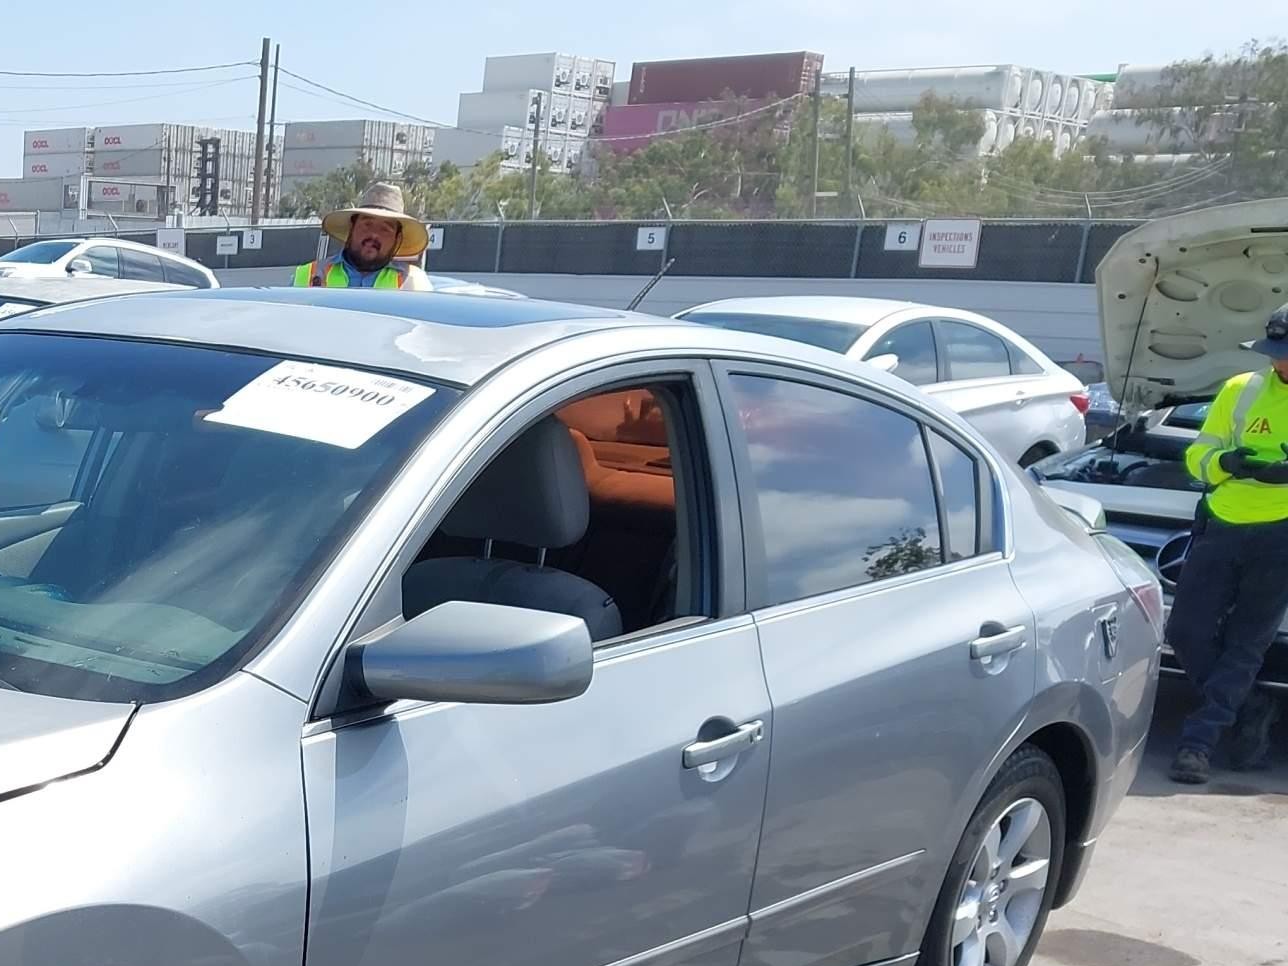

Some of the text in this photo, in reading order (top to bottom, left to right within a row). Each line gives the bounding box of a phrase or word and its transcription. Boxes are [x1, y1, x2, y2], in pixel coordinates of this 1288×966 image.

[647, 232, 655, 245] 5
[897, 231, 907, 245] 6
[929, 231, 973, 242] INSPECTIONS
[933, 243, 966, 255] VEHICLES
[272, 374, 396, 407] 45650900
